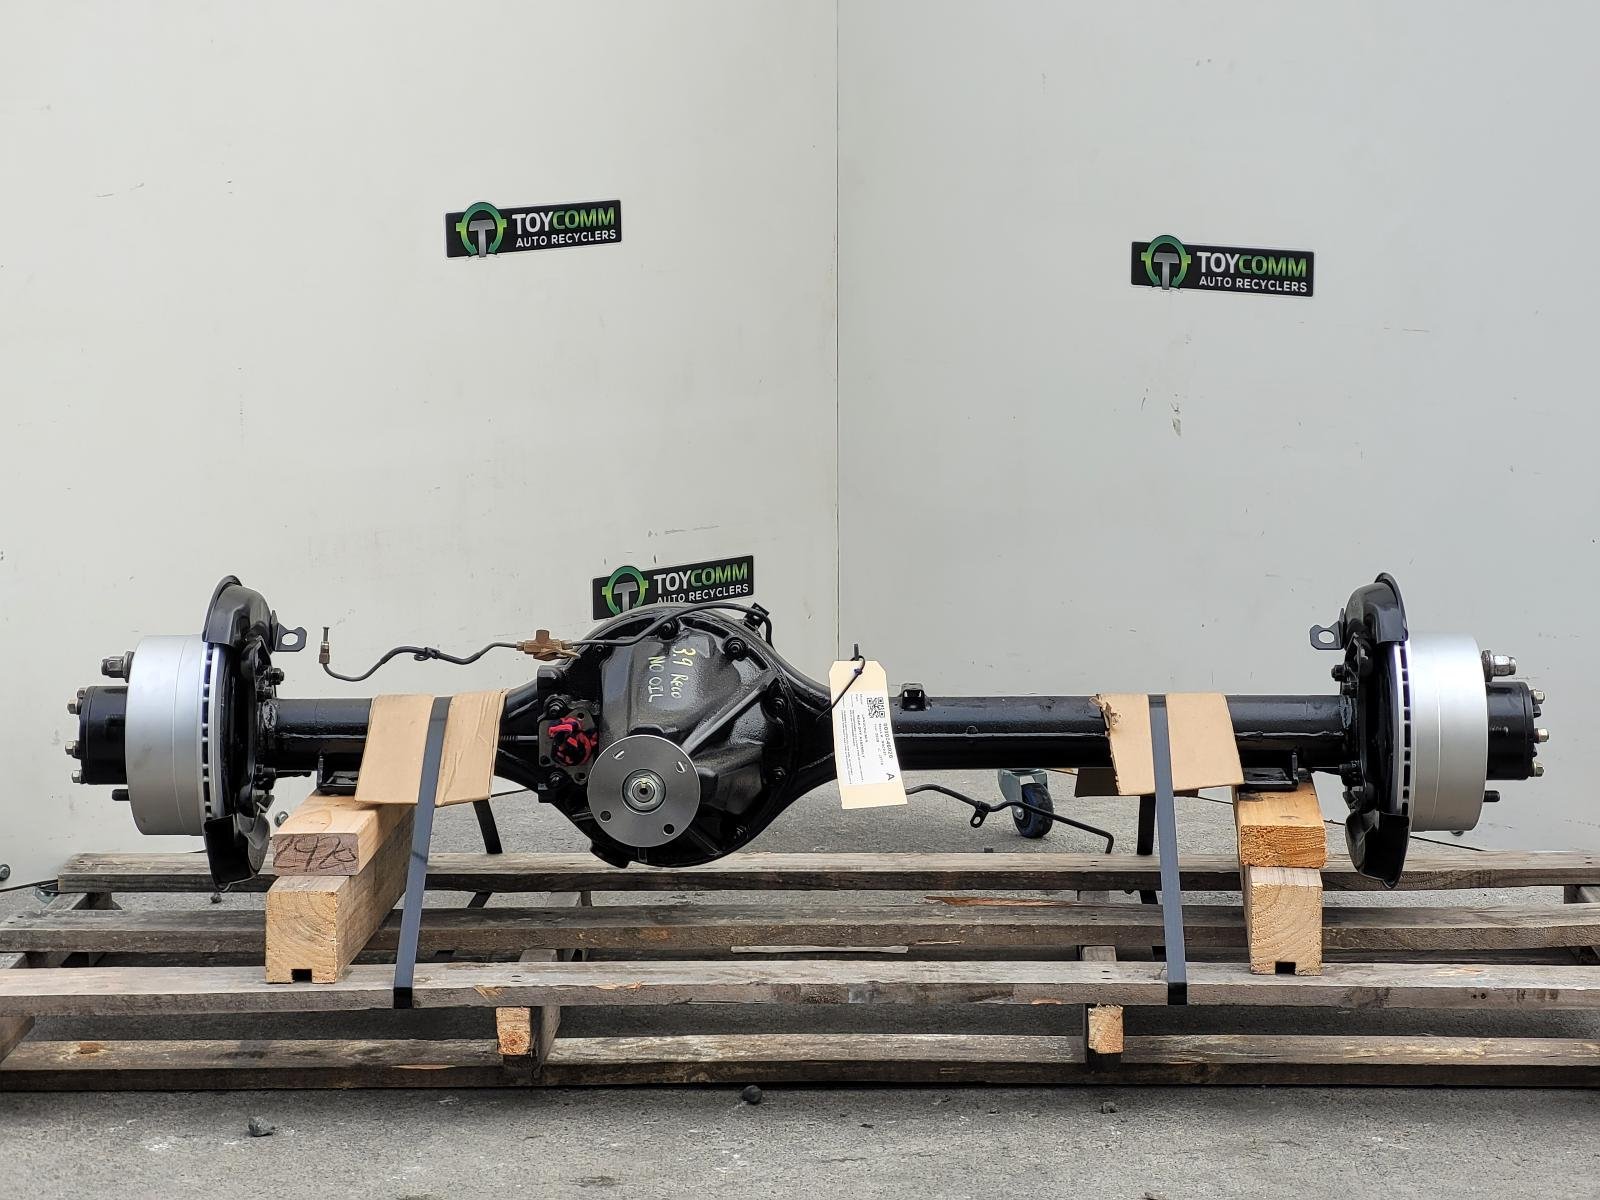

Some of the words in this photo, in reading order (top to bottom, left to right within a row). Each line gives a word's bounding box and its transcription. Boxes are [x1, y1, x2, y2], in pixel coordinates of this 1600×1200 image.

[511, 207, 615, 235] TOYCOMM
[515, 235, 548, 248] AUTO
[551, 229, 617, 245] RECYCLERS
[1196, 251, 1308, 278] TOYCOMM
[1199, 275, 1232, 288] AUTO
[1236, 278, 1308, 293] RECYCLERS
[653, 562, 748, 594] TOYCOMM
[657, 593, 686, 604] AUTO
[688, 583, 749, 602] RECYCLERS
[648, 655, 666, 672] NO
[672, 646, 696, 667] 3.9
[647, 676, 664, 703] OIL
[886, 772, 895, 781] A
